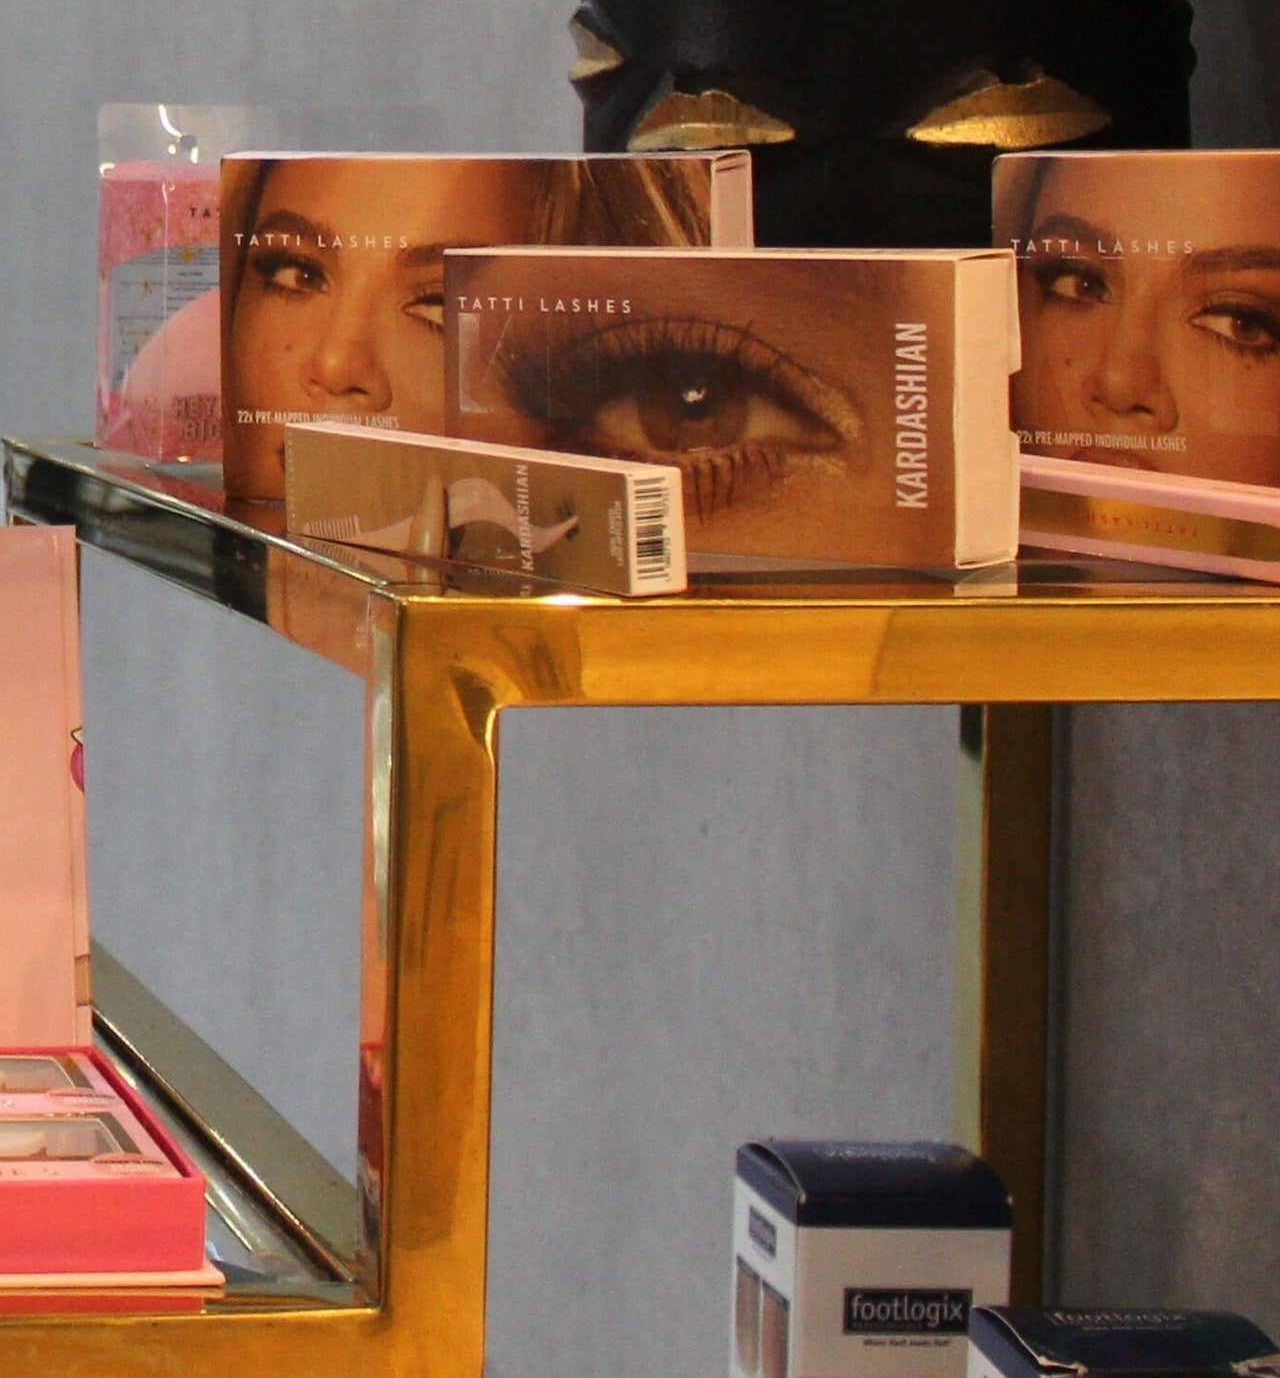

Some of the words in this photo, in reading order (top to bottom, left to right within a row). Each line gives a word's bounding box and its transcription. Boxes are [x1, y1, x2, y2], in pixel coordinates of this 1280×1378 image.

[235, 233, 301, 247] TATTI
[317, 234, 409, 249] LASHES
[1011, 238, 1080, 253] TATTI
[1097, 239, 1193, 254] LASHES
[458, 296, 524, 311] TATTI
[540, 298, 632, 314] LASHES
[895, 322, 928, 510] KARDASHIAN
[1035, 430, 1091, 447] PRE-MAPPED
[1095, 432, 1148, 450] INDIVIDUAL
[1151, 436, 1187, 452] LASHES
[516, 464, 534, 572] KARDASHIAN
[851, 1295, 963, 1328] footlogix
